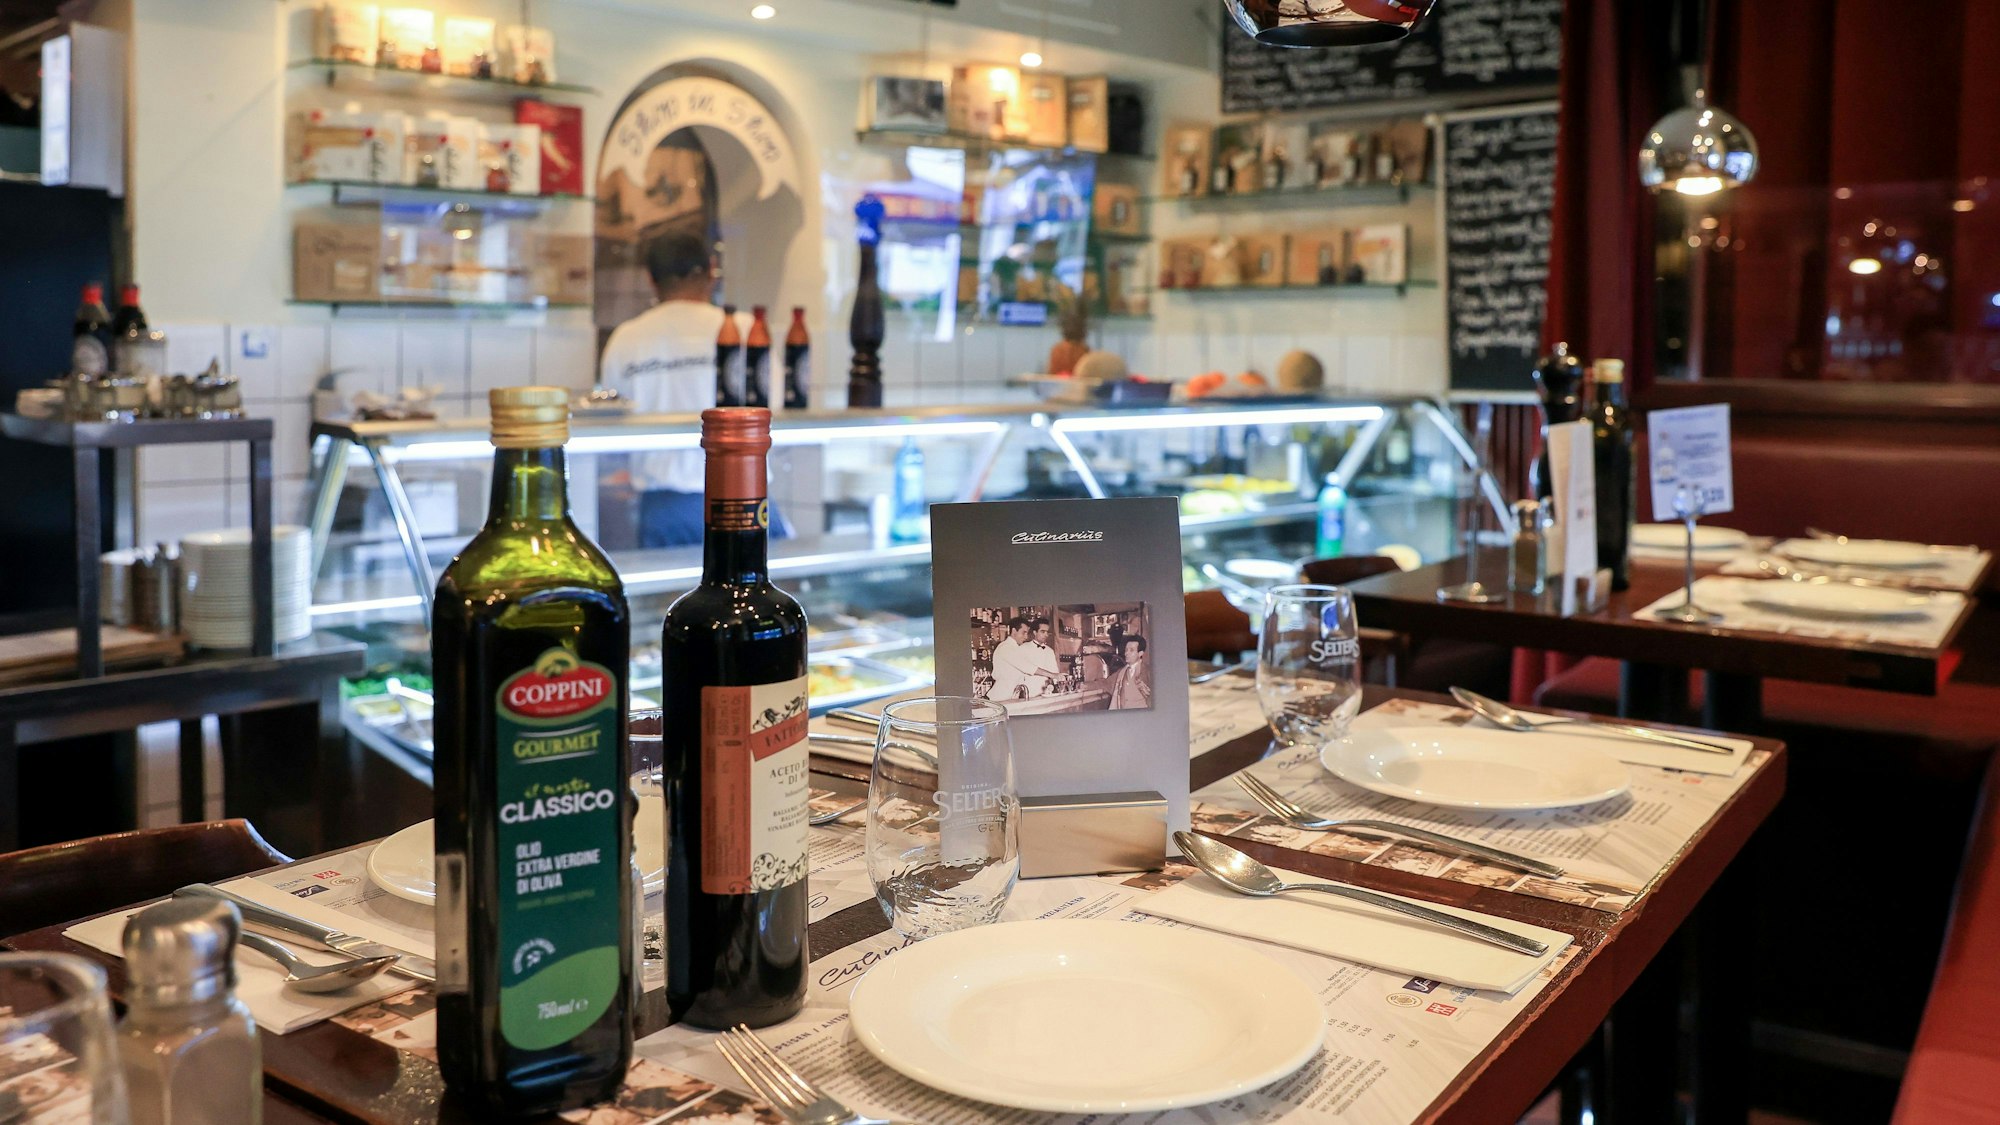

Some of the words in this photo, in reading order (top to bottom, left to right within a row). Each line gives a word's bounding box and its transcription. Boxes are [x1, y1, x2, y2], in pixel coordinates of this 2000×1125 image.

[1011, 530, 1103, 543] Culinarius
[1308, 636, 1360, 662] SELTERS
[510, 677, 603, 707] COPPINI
[513, 729, 601, 758] GOURMET
[769, 762, 800, 779] ACETO
[788, 774, 798, 785] DI
[500, 788, 614, 824] CLASSICO
[928, 783, 1013, 821] SELTERS
[516, 841, 542, 859] OLIO
[517, 856, 553, 877] EXTRA
[554, 848, 600, 869] VERGINE
[517, 878, 529, 894] DI
[530, 872, 563, 892] OLIVA
